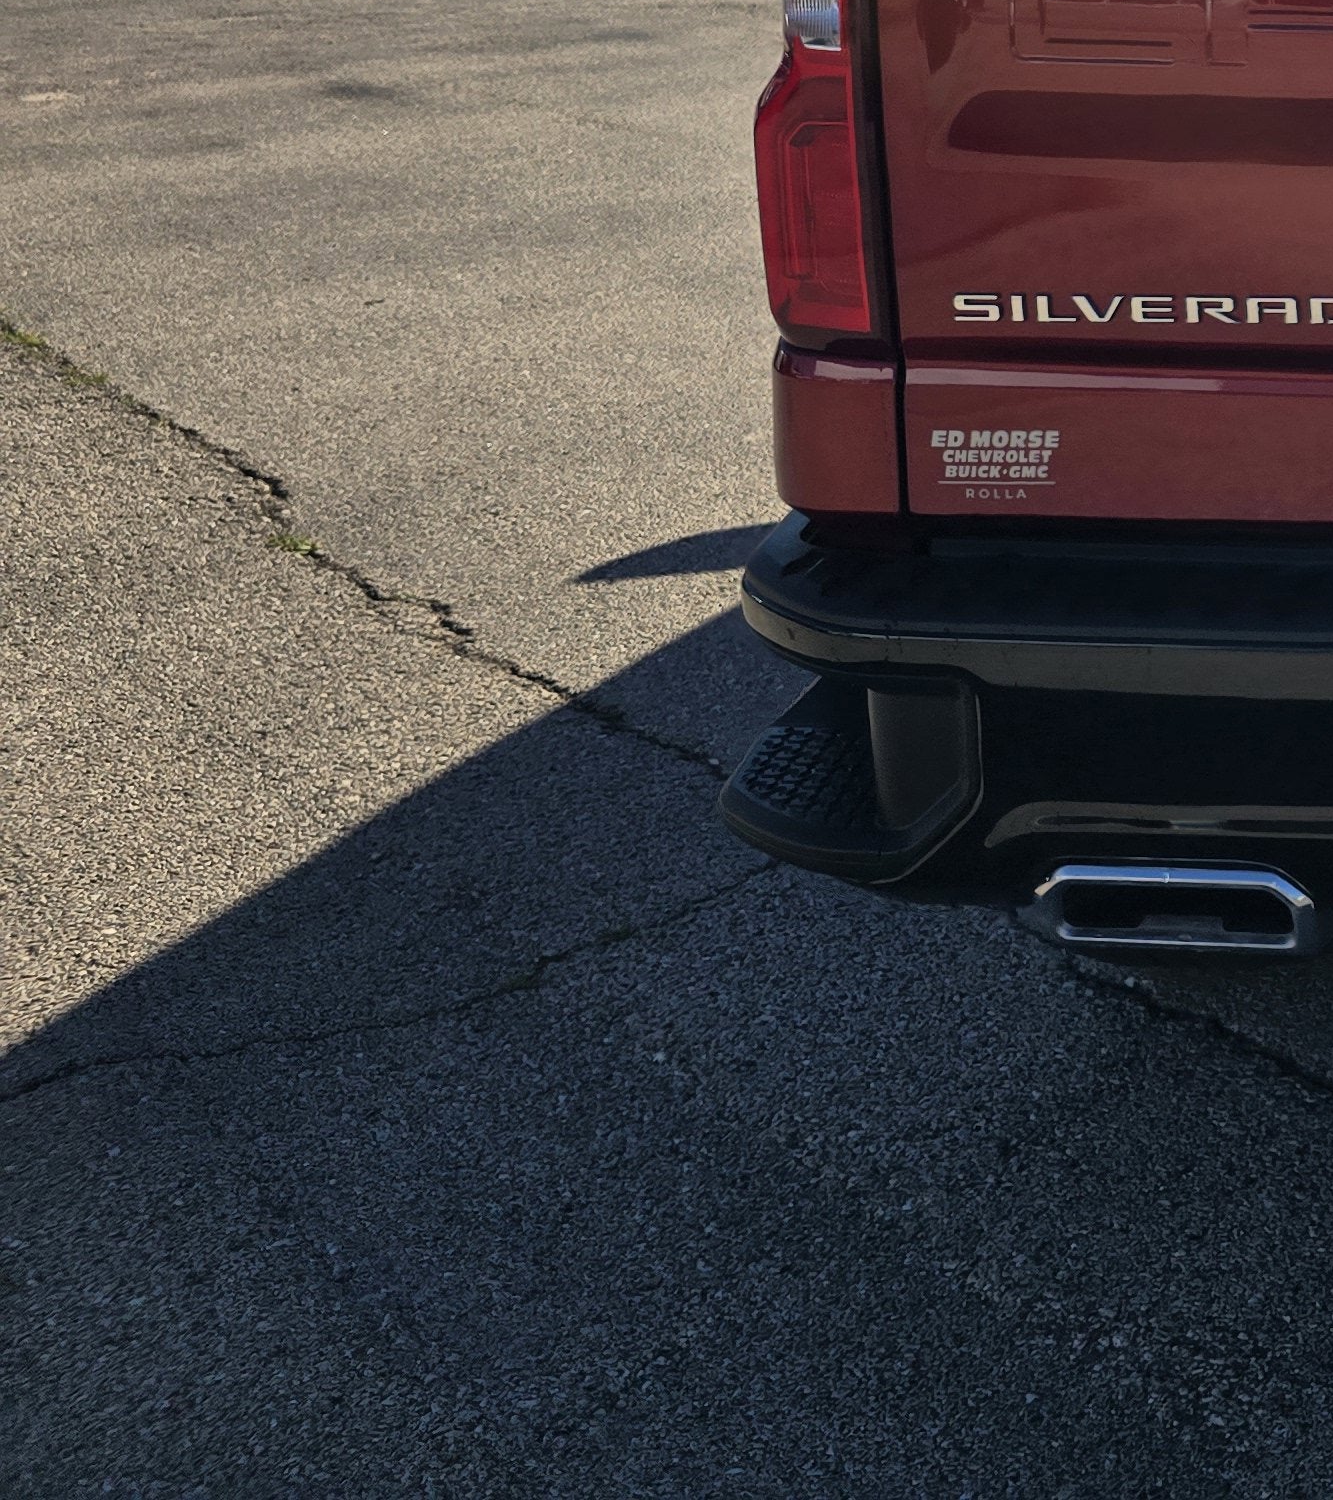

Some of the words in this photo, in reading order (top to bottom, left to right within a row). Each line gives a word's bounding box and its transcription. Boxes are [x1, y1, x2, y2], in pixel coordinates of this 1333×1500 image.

[931, 429, 965, 448] ED
[970, 429, 1060, 448] MORSE
[942, 449, 1053, 463] CHEVROLET
[965, 488, 1027, 499] ROLLA
